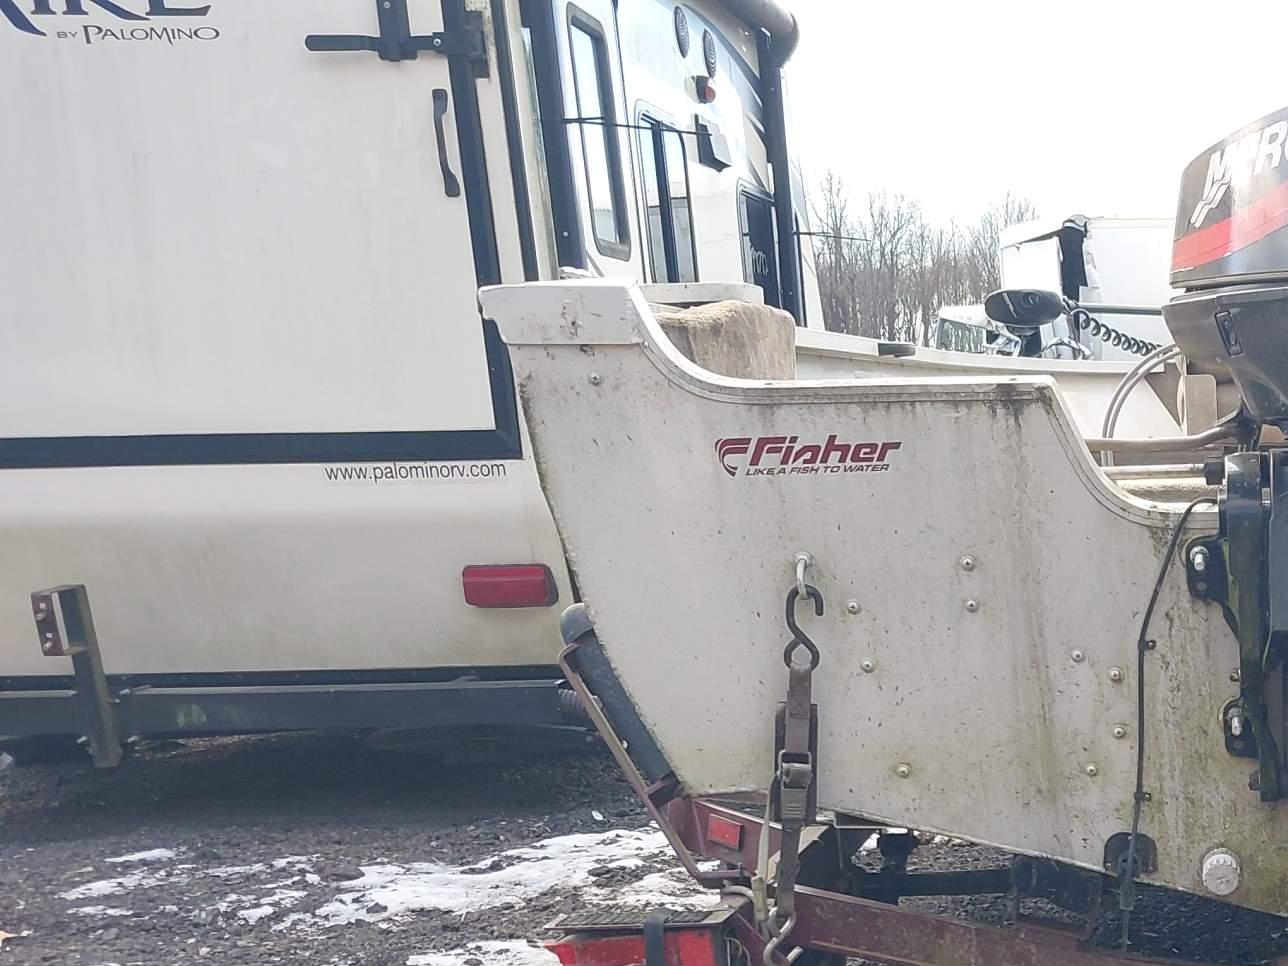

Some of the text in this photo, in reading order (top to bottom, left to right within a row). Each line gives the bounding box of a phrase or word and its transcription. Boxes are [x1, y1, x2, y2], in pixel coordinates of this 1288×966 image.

[56, 25, 220, 45] BY PALOMINO
[750, 435, 902, 466] Fisher
[325, 462, 506, 485] www.palominorv.com
[746, 463, 890, 477] LIKE A FISH TO WATER
